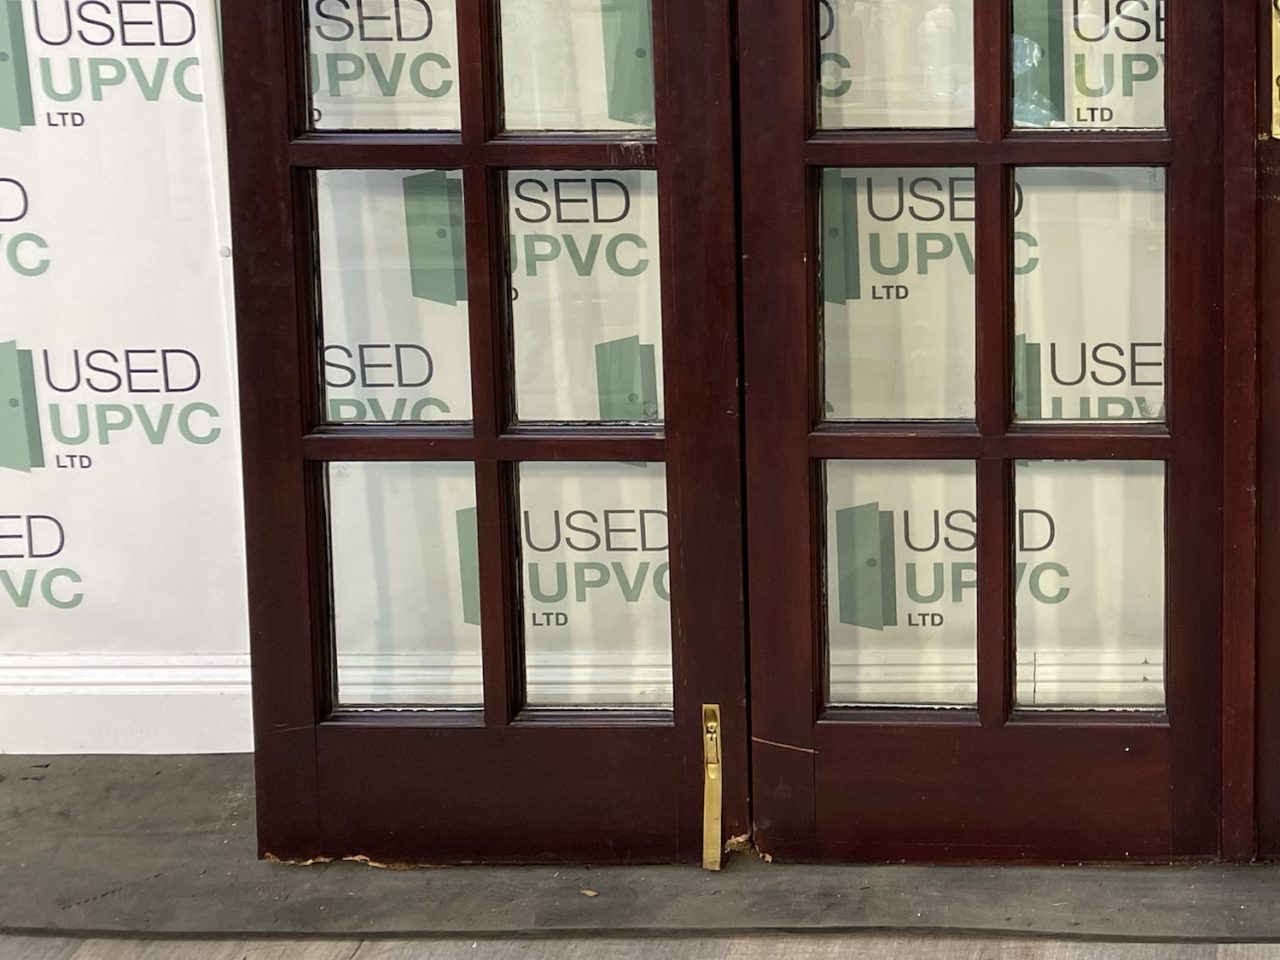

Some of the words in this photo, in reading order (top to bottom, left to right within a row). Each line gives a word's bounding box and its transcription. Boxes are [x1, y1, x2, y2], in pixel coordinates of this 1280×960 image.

[33, 0, 196, 47] USED
[310, 52, 453, 98] PVC
[46, 111, 85, 127] LTD
[1076, 107, 1113, 123] LTD
[514, 178, 631, 223] SED
[509, 233, 649, 277] PVC
[872, 285, 909, 300] LTD
[43, 348, 201, 393] USED
[324, 344, 434, 388] SED
[1050, 342, 1163, 387] USE
[48, 402, 222, 445] UPVC
[56, 454, 92, 469] LTD
[0, 568, 84, 609] VC
[532, 612, 568, 627] LTD
[908, 613, 944, 627] LTD
